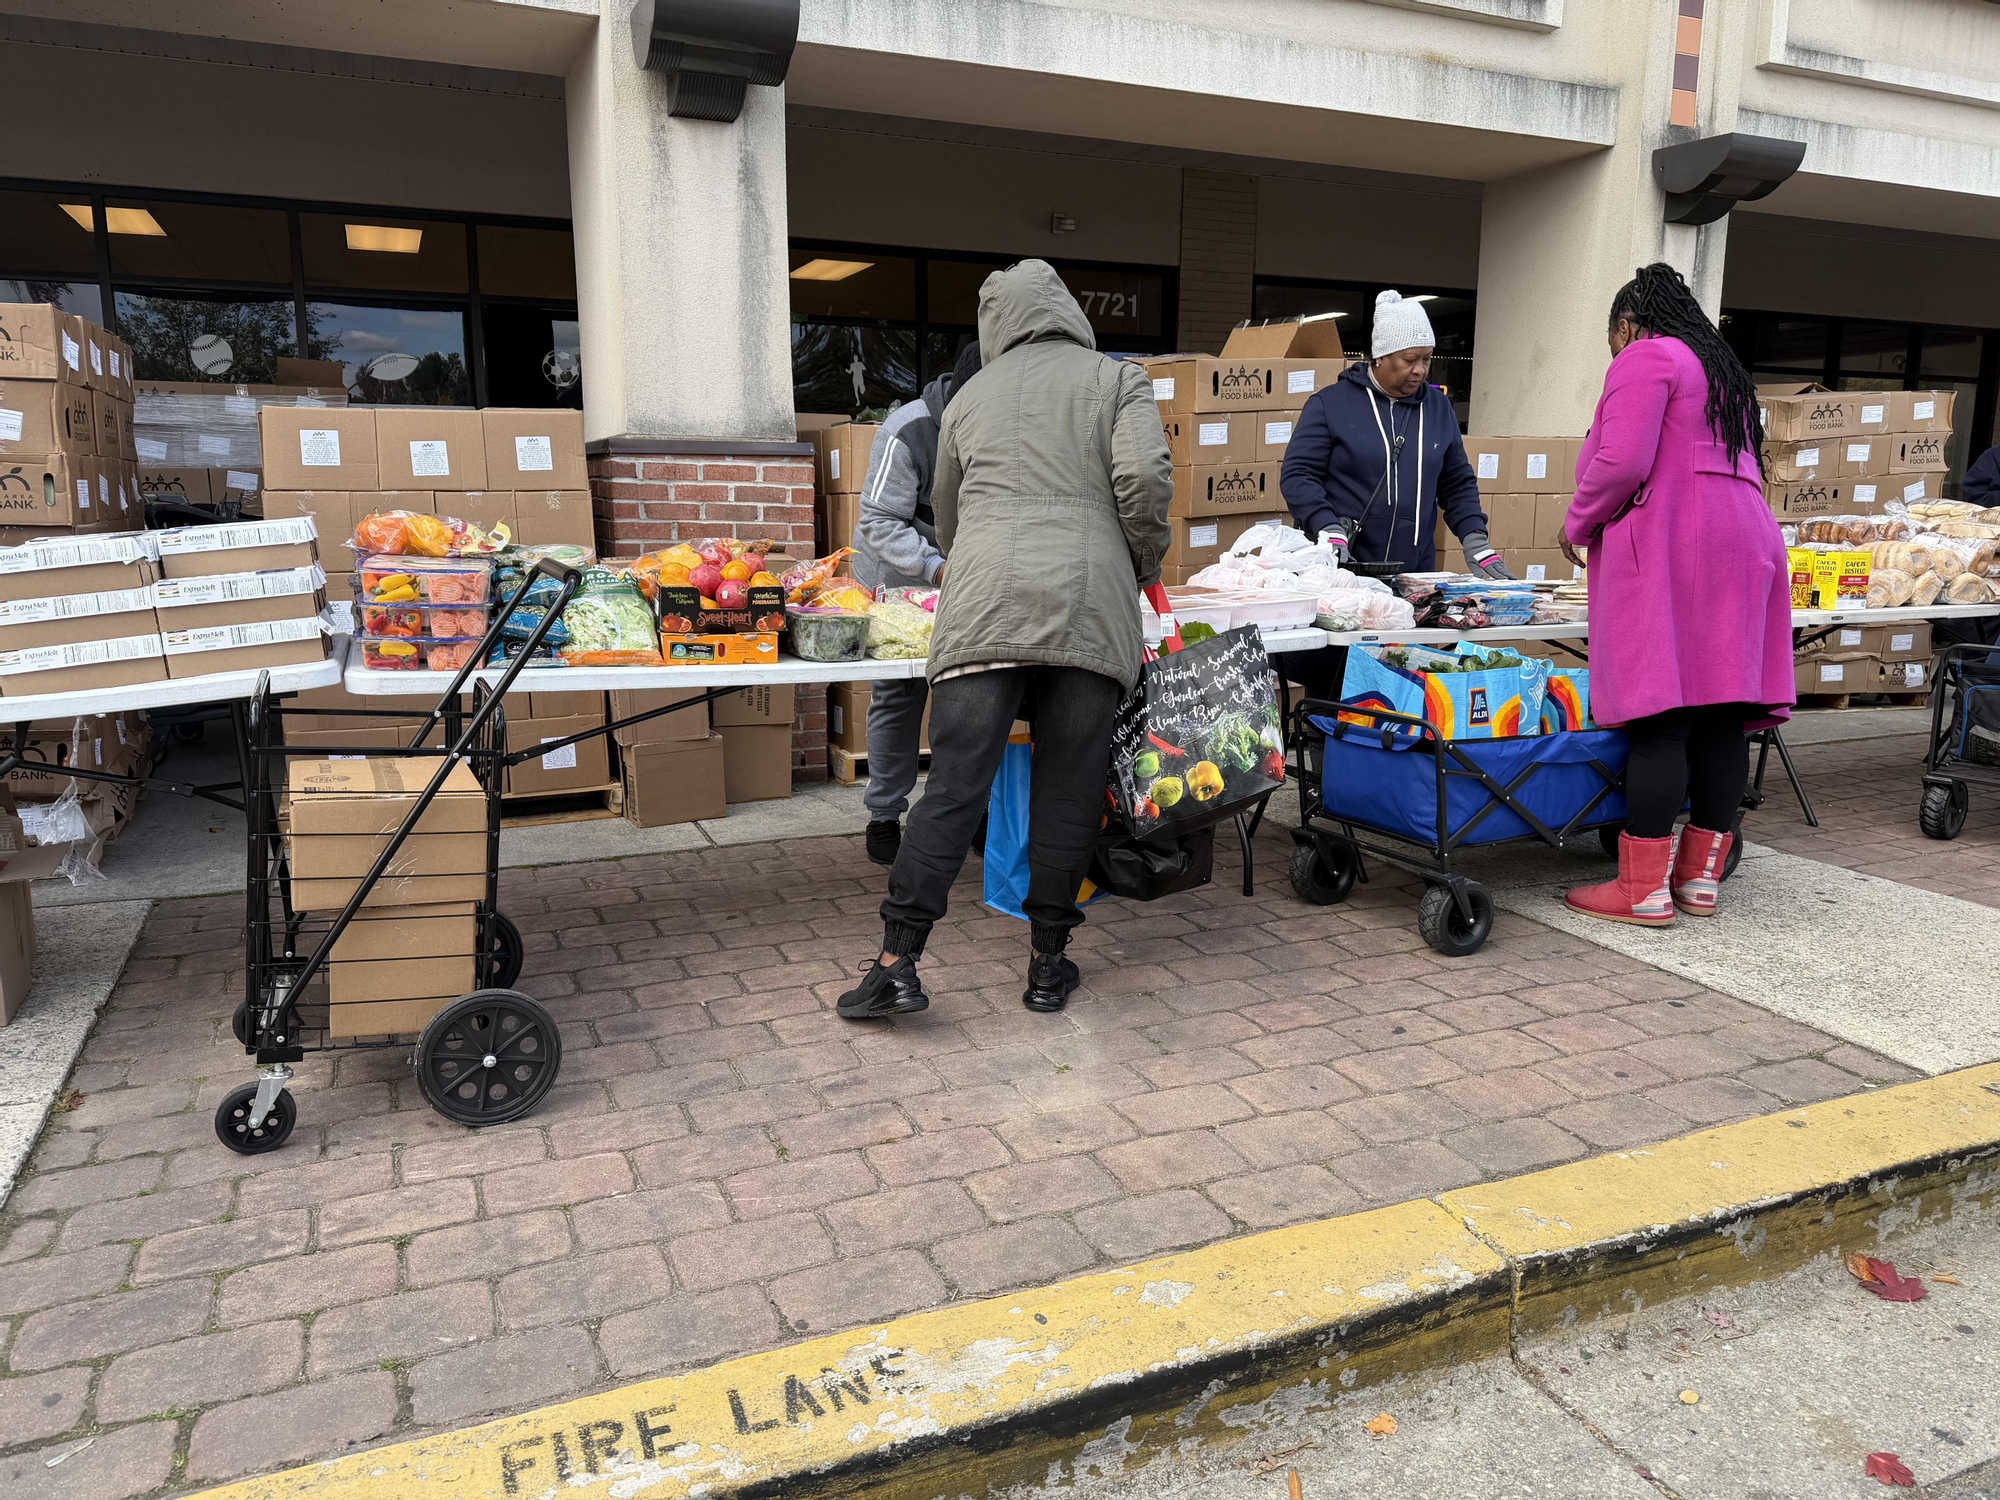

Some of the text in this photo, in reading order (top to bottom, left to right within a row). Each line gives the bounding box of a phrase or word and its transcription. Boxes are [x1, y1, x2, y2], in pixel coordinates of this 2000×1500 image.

[1081, 290, 1137, 318] 7721
[1221, 392, 1241, 400] FOOD
[0, 500, 34, 509] ANK
[697, 611, 721, 626] Sweet
[1149, 663, 1200, 686] Natural
[1208, 634, 1248, 671] Seasonal
[1189, 704, 1222, 722] Ripe
[1473, 711, 1488, 719] ALDI
[11, 771, 49, 779] BANK
[501, 1403, 688, 1494] FIRE
